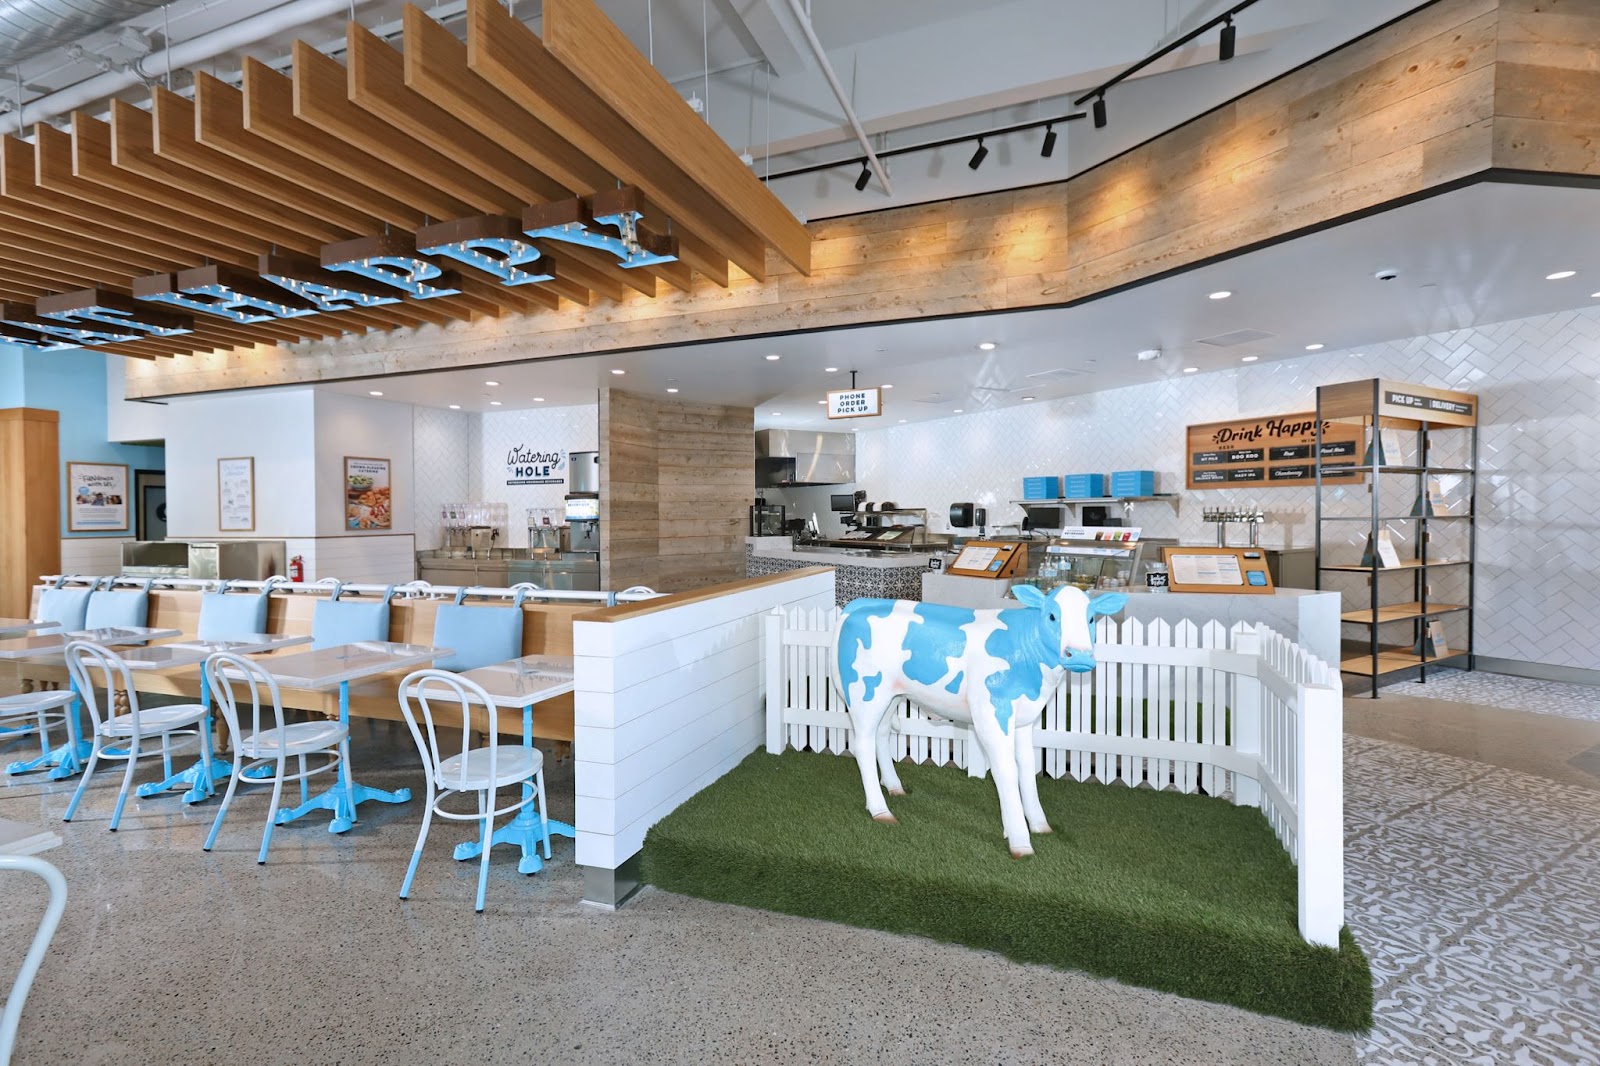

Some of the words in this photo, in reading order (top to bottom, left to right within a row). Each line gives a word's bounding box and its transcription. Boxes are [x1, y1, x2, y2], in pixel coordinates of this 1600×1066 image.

[133, 189, 678, 323] HAPPY
[1392, 394, 1405, 404] PICK
[1406, 396, 1414, 405] UP
[1432, 400, 1456, 410] DELIVERY
[1217, 425, 1262, 442] Drink
[1266, 420, 1322, 438] Happy
[507, 444, 561, 470] Watering
[516, 466, 550, 478] HOLE
